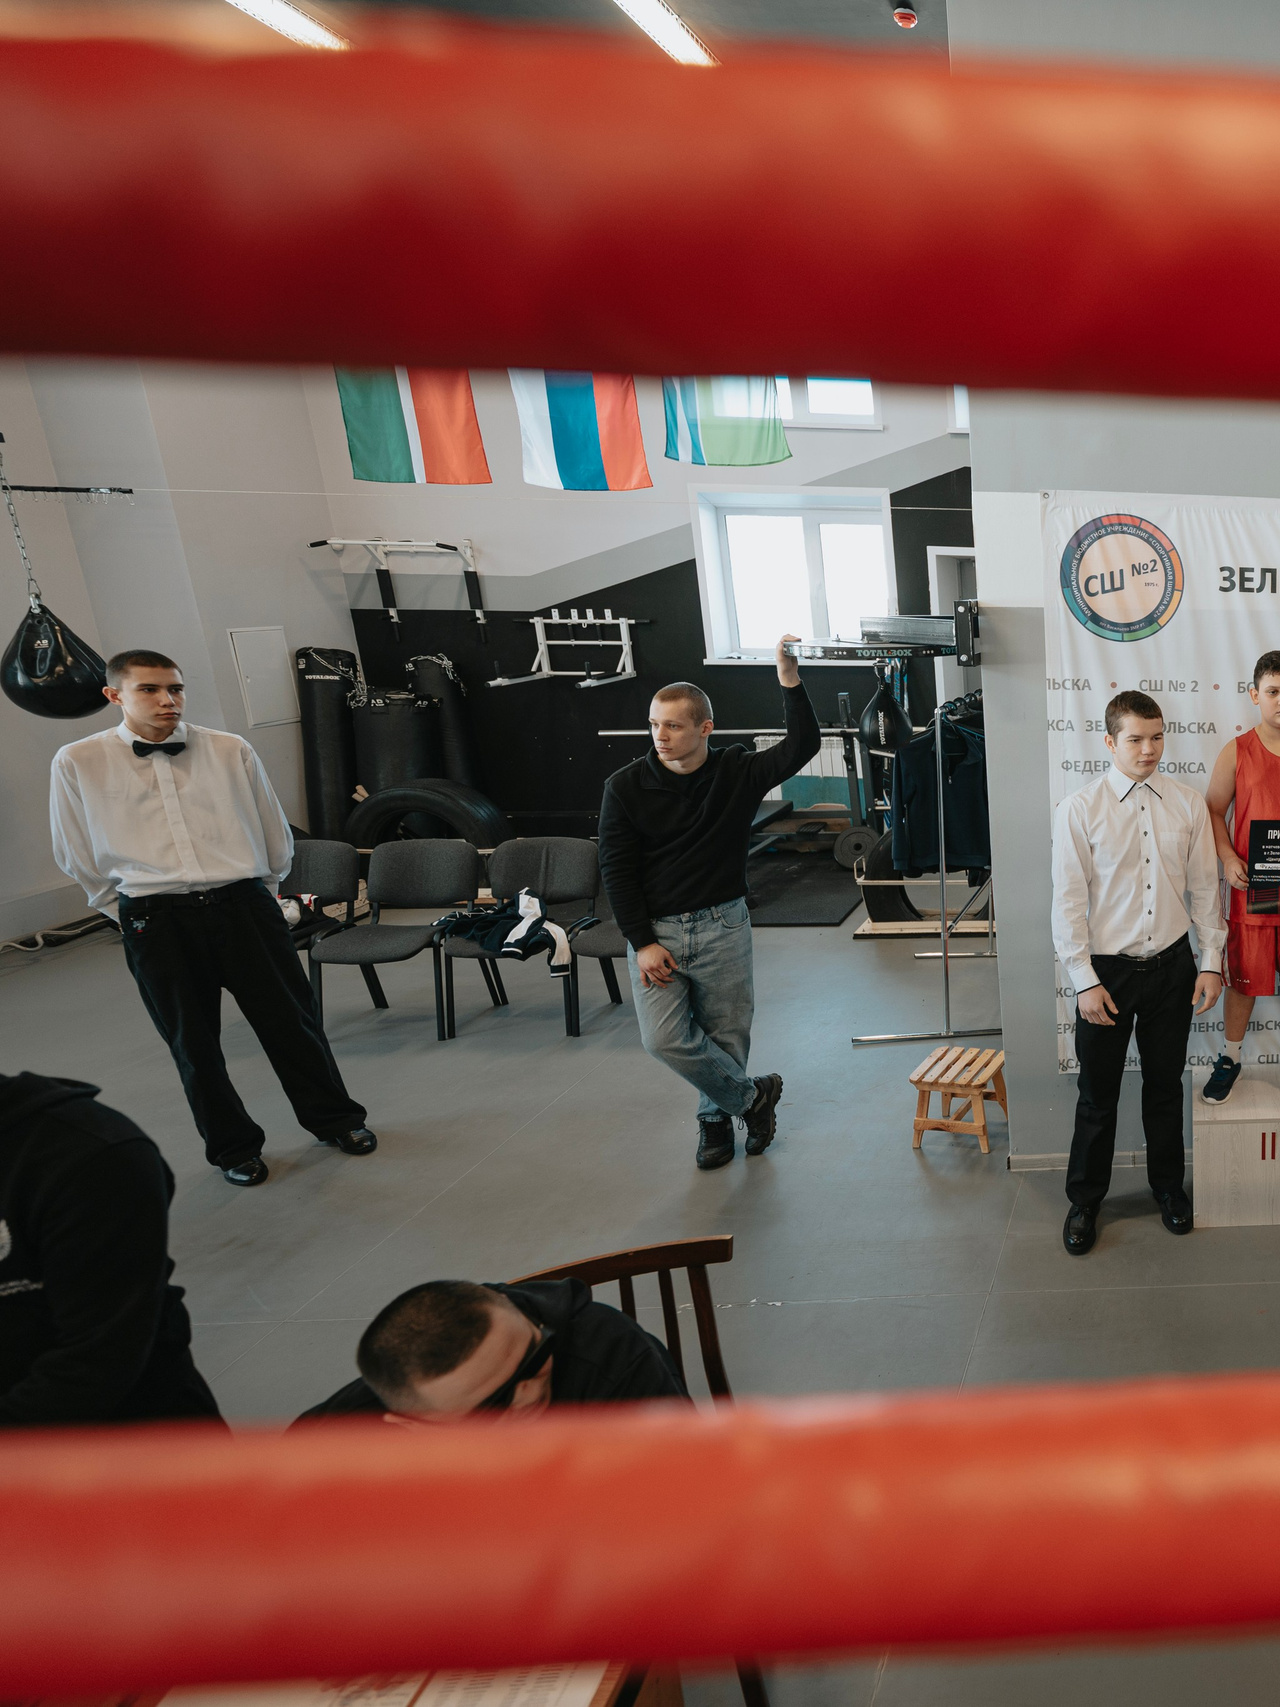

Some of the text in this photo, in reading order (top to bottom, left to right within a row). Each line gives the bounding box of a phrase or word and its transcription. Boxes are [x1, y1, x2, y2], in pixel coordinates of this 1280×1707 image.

[1076, 528, 1106, 559] БЮДЖЕТНОЕ
[1107, 525, 1149, 540] УЧРЕЖДЕНИЕ
[1084, 559, 1158, 597] СШ №2
[1139, 680, 1199, 693] СШ № 2
